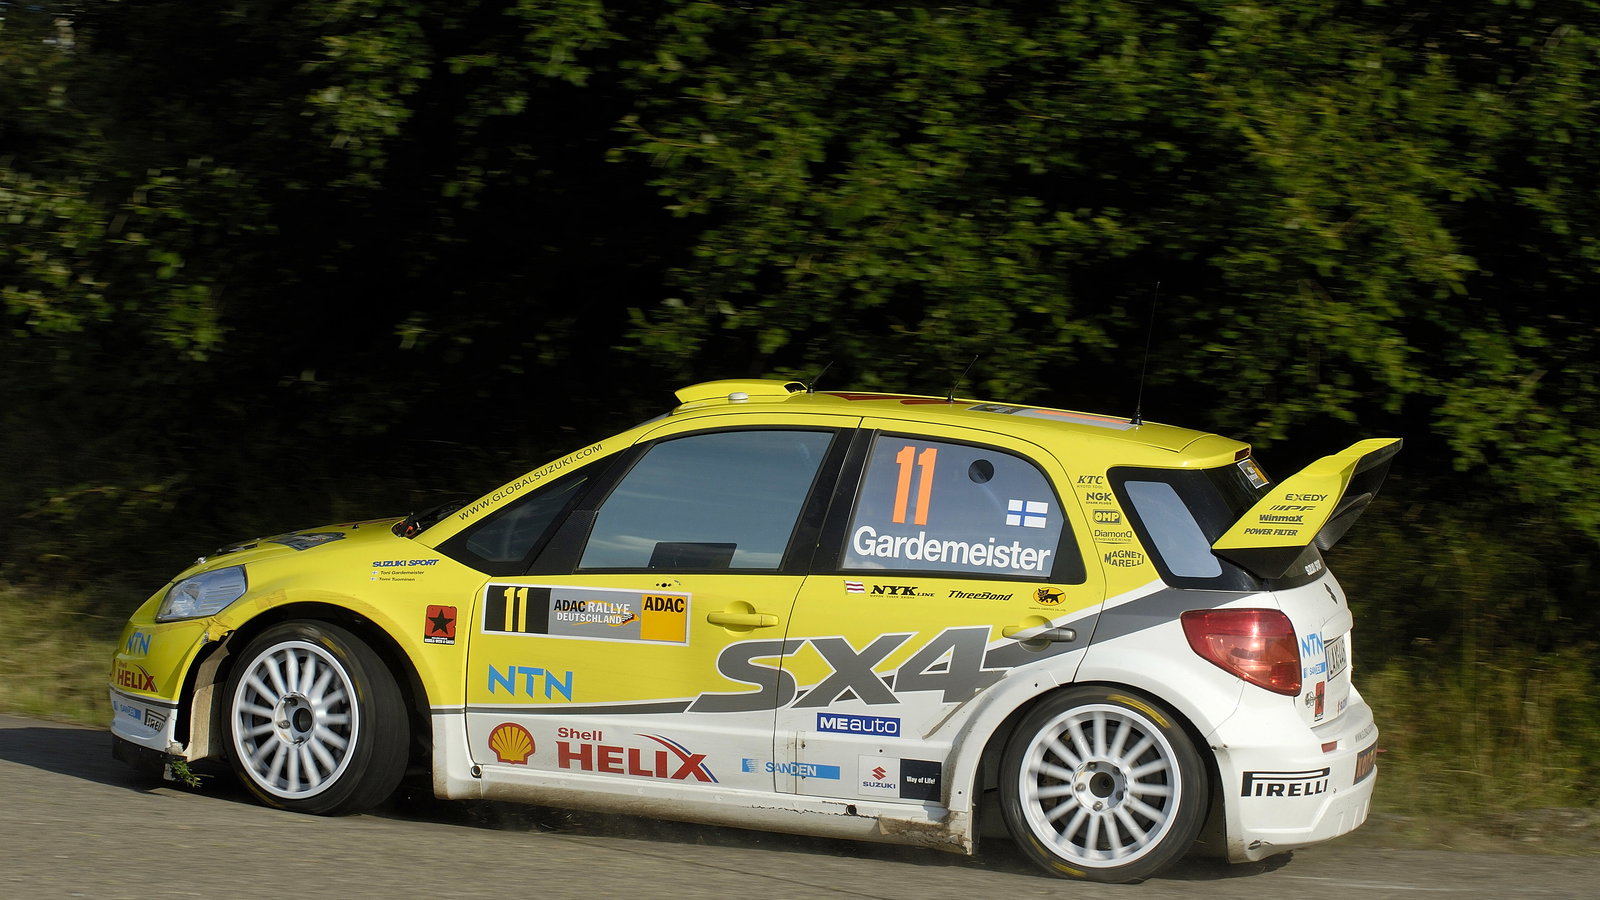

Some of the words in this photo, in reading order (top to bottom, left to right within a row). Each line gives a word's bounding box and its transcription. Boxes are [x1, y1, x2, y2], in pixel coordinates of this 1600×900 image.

[458, 443, 603, 521] WWW.GLOBALSUZUKI.COM
[891, 445, 938, 526] 11
[1076, 475, 1104, 485] KTC
[1086, 492, 1112, 501] NGK
[1285, 493, 1328, 502] EXEDY
[1094, 511, 1120, 522] OMP
[853, 525, 1051, 571] Gardemeister
[1104, 550, 1144, 563] MAGNETI
[1104, 554, 1144, 567] MARELLI
[870, 585, 918, 596] NYK
[947, 589, 1014, 601] ThreeBond
[503, 586, 529, 633] 11
[553, 599, 586, 613] ADAC
[587, 601, 631, 615] RALLYE
[643, 596, 685, 613] ADAC
[556, 611, 623, 625] DEUTSCHLAND
[125, 632, 152, 656] NTN
[1301, 631, 1324, 659] NTN
[682, 625, 1003, 714] SX4
[116, 668, 156, 692] HELIX
[487, 663, 574, 702] NTN
[557, 727, 603, 742] Shell
[555, 738, 715, 783] HELIX
[764, 761, 817, 777] SANDEN
[862, 781, 896, 789] SUZUKI
[906, 775, 917, 784] Way
[1241, 767, 1330, 797] PIRELLI
